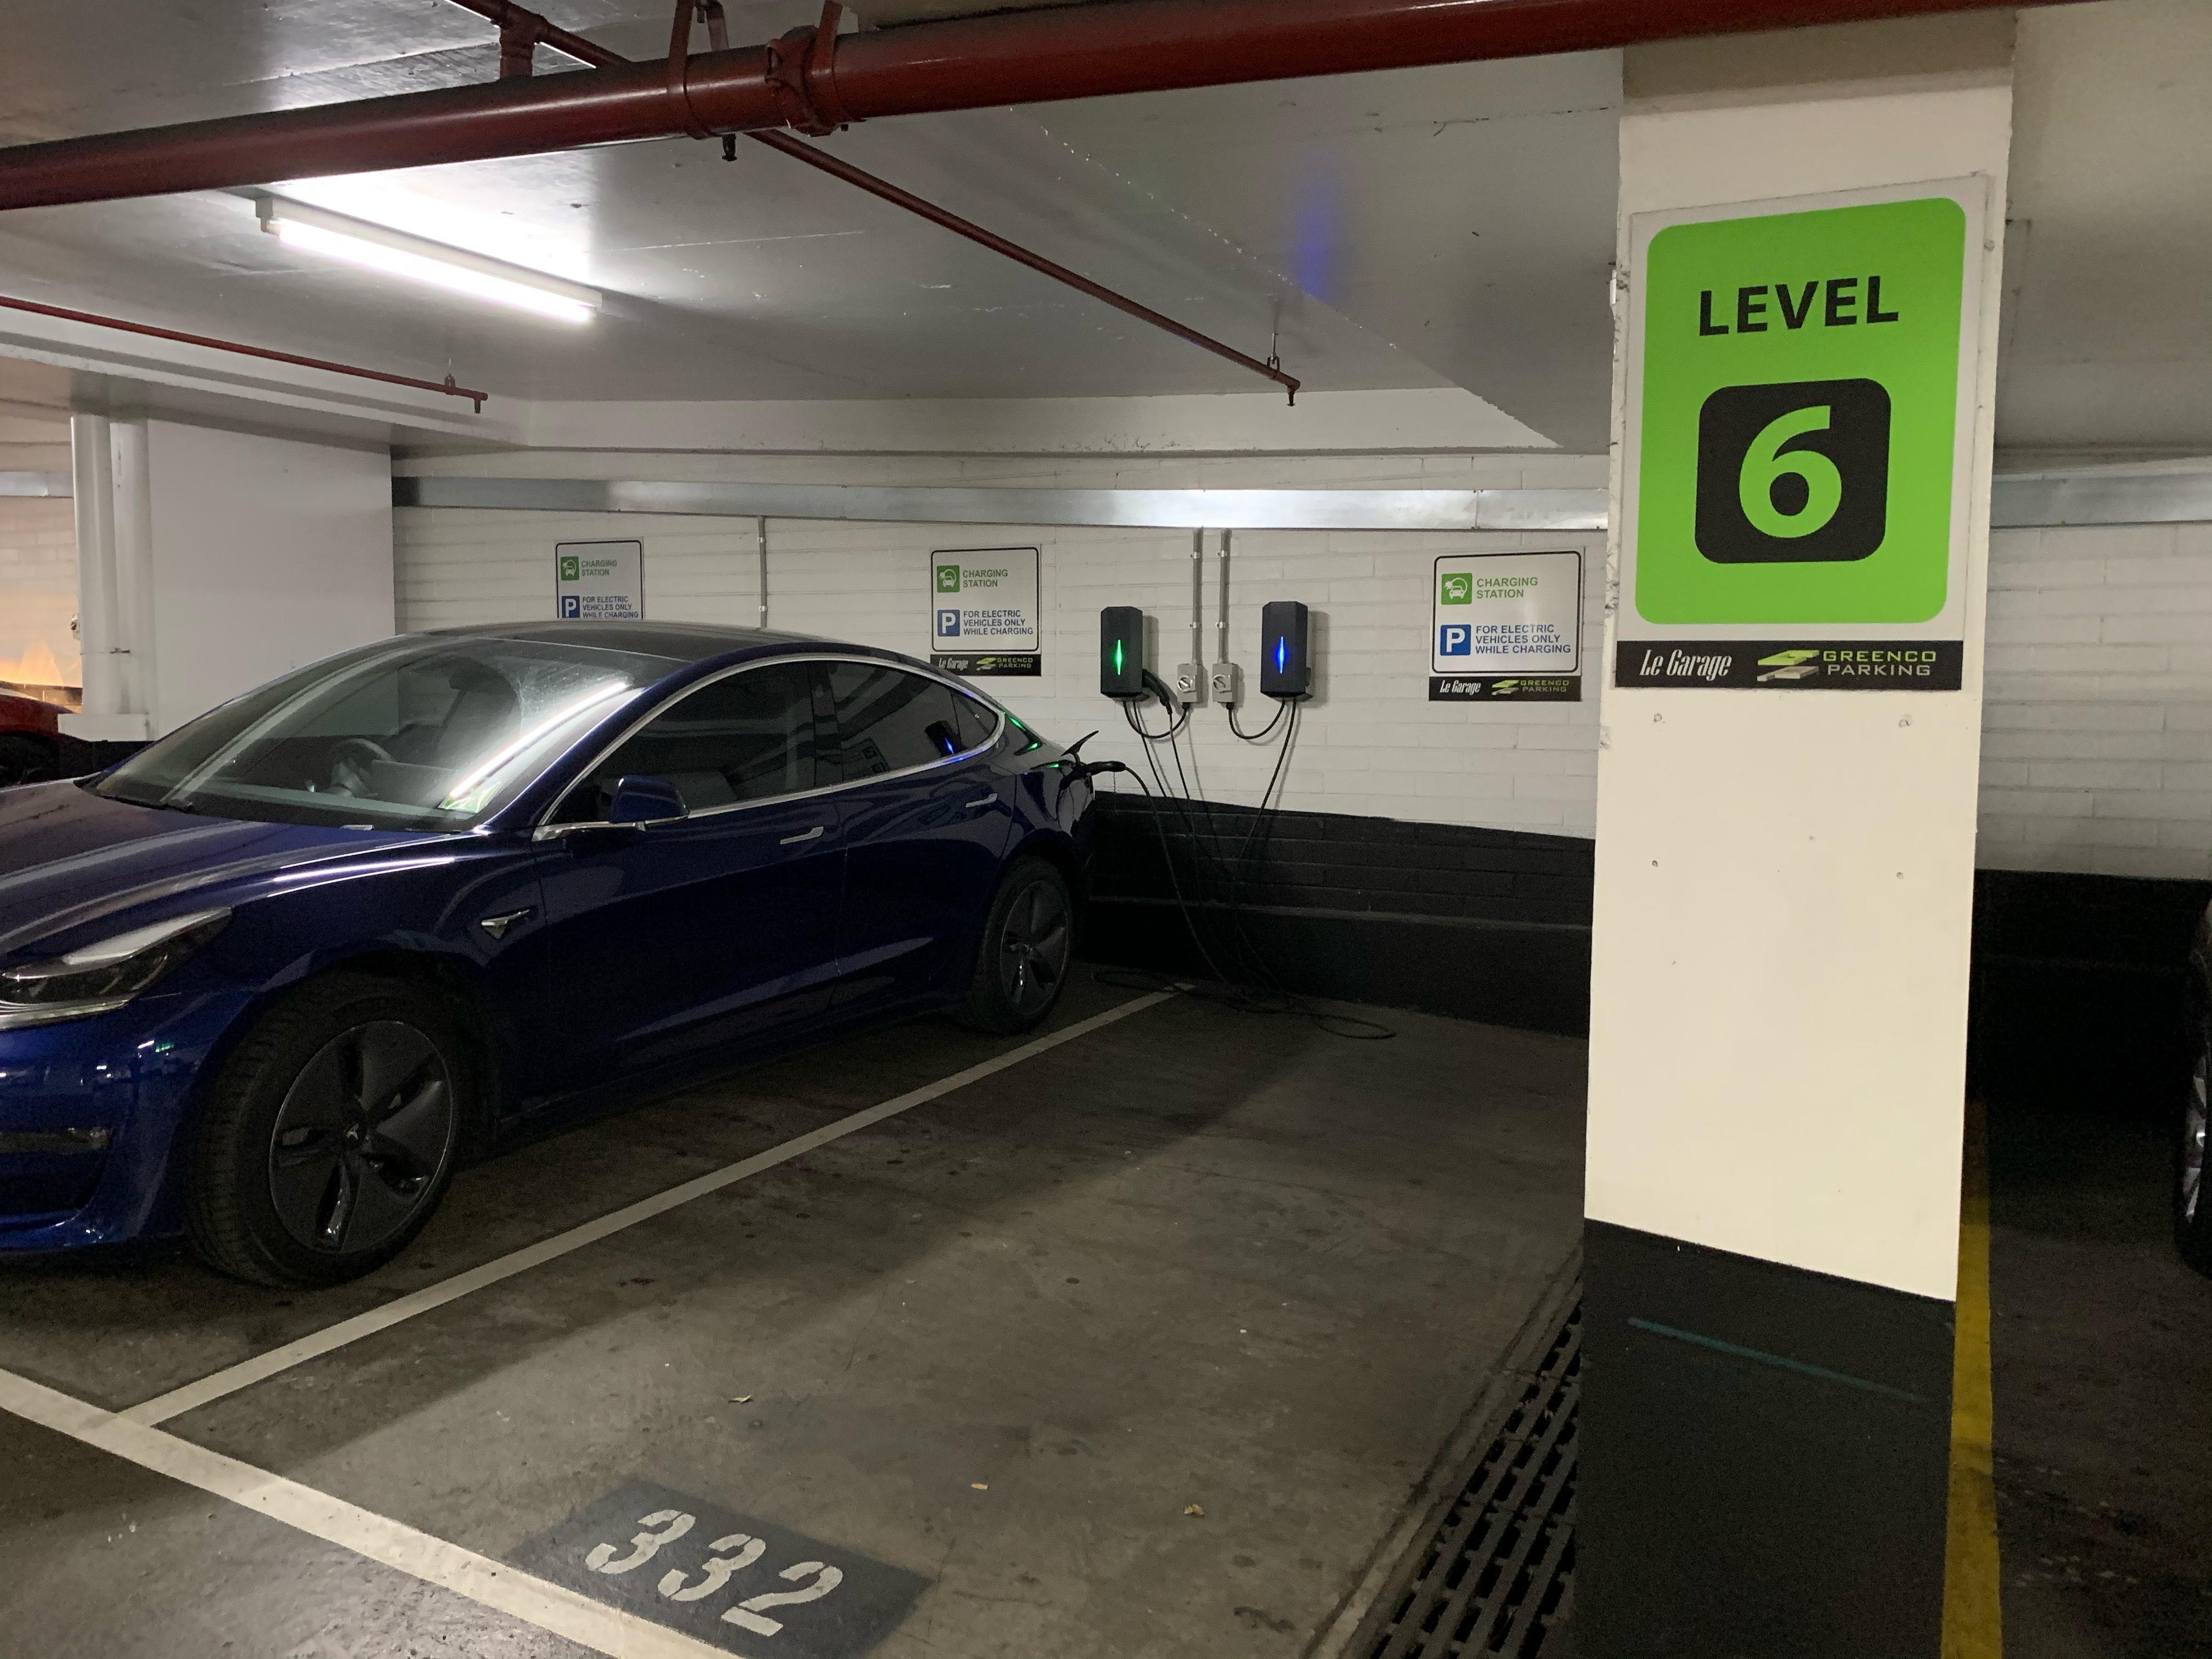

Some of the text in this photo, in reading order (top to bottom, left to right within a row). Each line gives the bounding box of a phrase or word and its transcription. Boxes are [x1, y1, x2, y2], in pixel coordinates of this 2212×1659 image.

[1699, 275, 1899, 336] LEVEL
[1739, 405, 1842, 539] 6
[963, 569, 1008, 578] CHARGING
[963, 579, 998, 588] STATION
[1477, 577, 1538, 587] CHARGING
[1477, 589, 1524, 599] STATION
[1476, 624, 1554, 634] FOR ELECTRIC
[1476, 635, 1561, 644] VEHICLES ONLY
[1475, 645, 1571, 654] WHILE CHARGING
[1822, 650, 1937, 662] GREENCO
[939, 657, 969, 671] Le Garage
[1639, 648, 1733, 681] Le Garage
[1827, 664, 1931, 676] PARKING
[1440, 679, 1481, 696] Le Garage
[584, 1509, 843, 1637] 332
